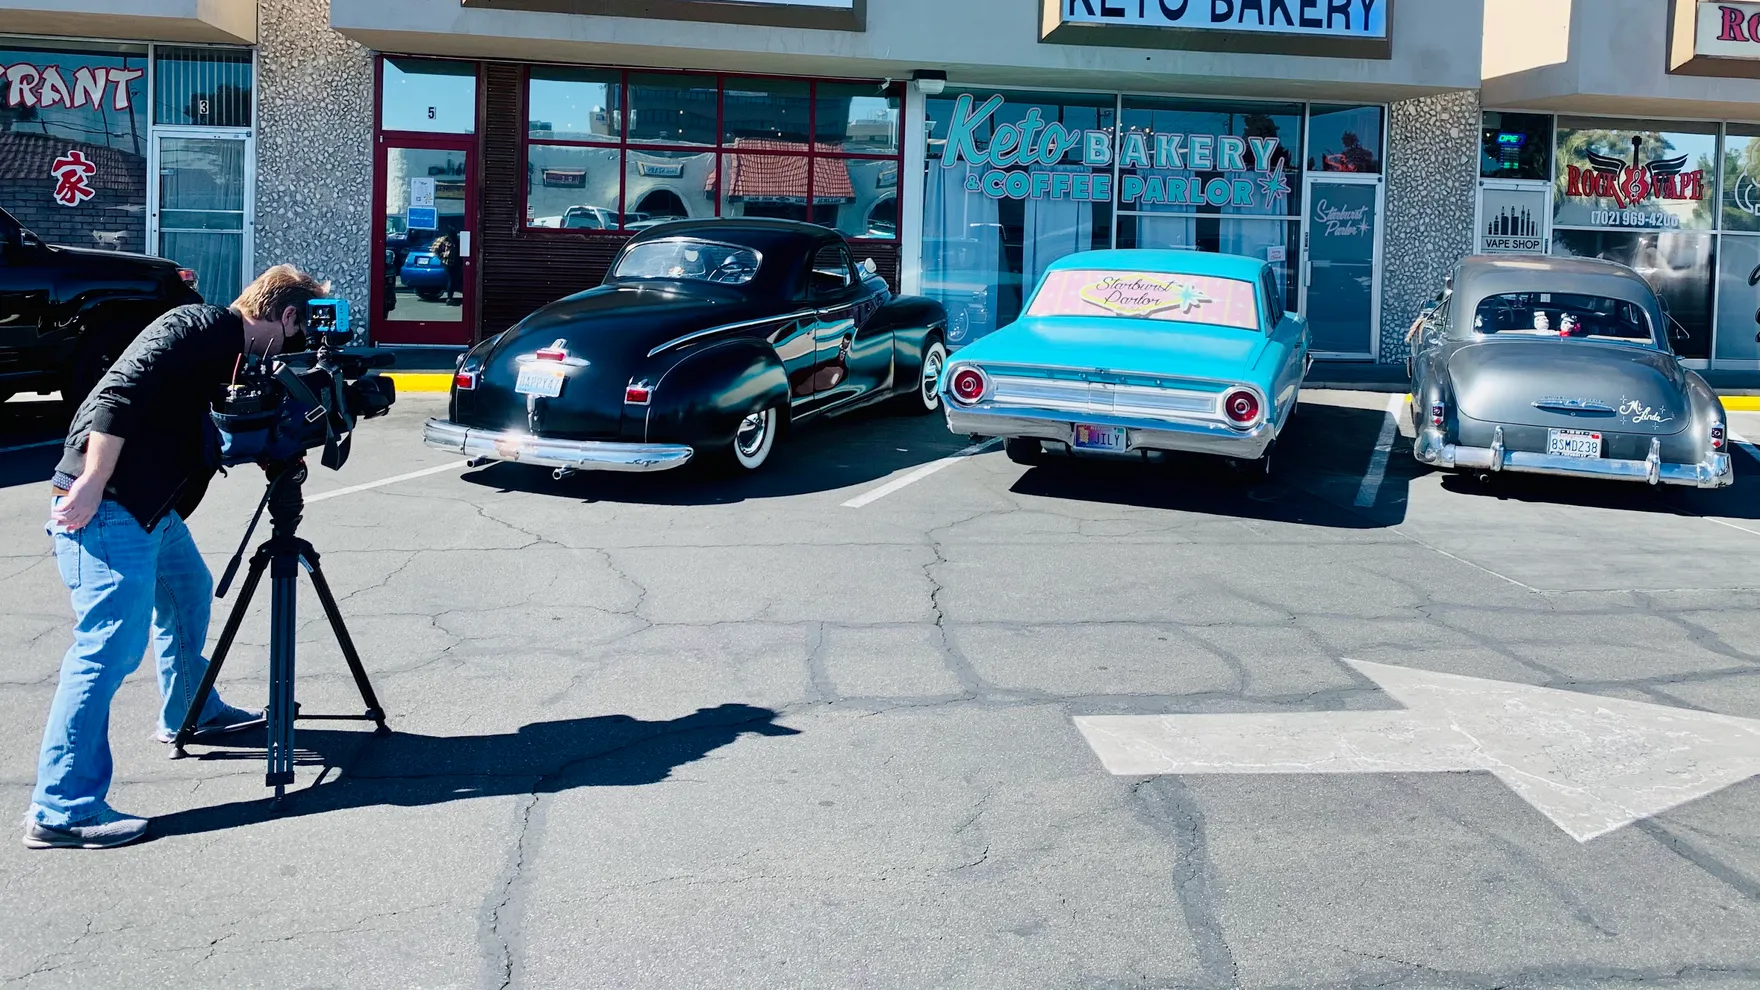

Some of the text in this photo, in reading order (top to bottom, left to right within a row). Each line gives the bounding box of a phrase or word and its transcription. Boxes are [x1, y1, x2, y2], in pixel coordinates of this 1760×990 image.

[0, 62, 144, 111] RANT
[200, 100, 209, 114] 3
[428, 106, 436, 119] 5
[941, 93, 1279, 172] Keto BAKERY
[51, 150, 97, 207] 家
[1566, 164, 1704, 209] ROCK VAPE
[1122, 175, 1254, 207] PARLOR
[1314, 199, 1368, 222] Starburst
[1325, 221, 1358, 237] Parlor
[1486, 239, 1540, 249] VAPE SHOP
[1096, 276, 1175, 293] Starburst
[1104, 290, 1161, 307] Parlor
[1620, 400, 1643, 415] Mi
[1632, 406, 1674, 423] Linda
[1551, 438, 1598, 454] 8SMD238
